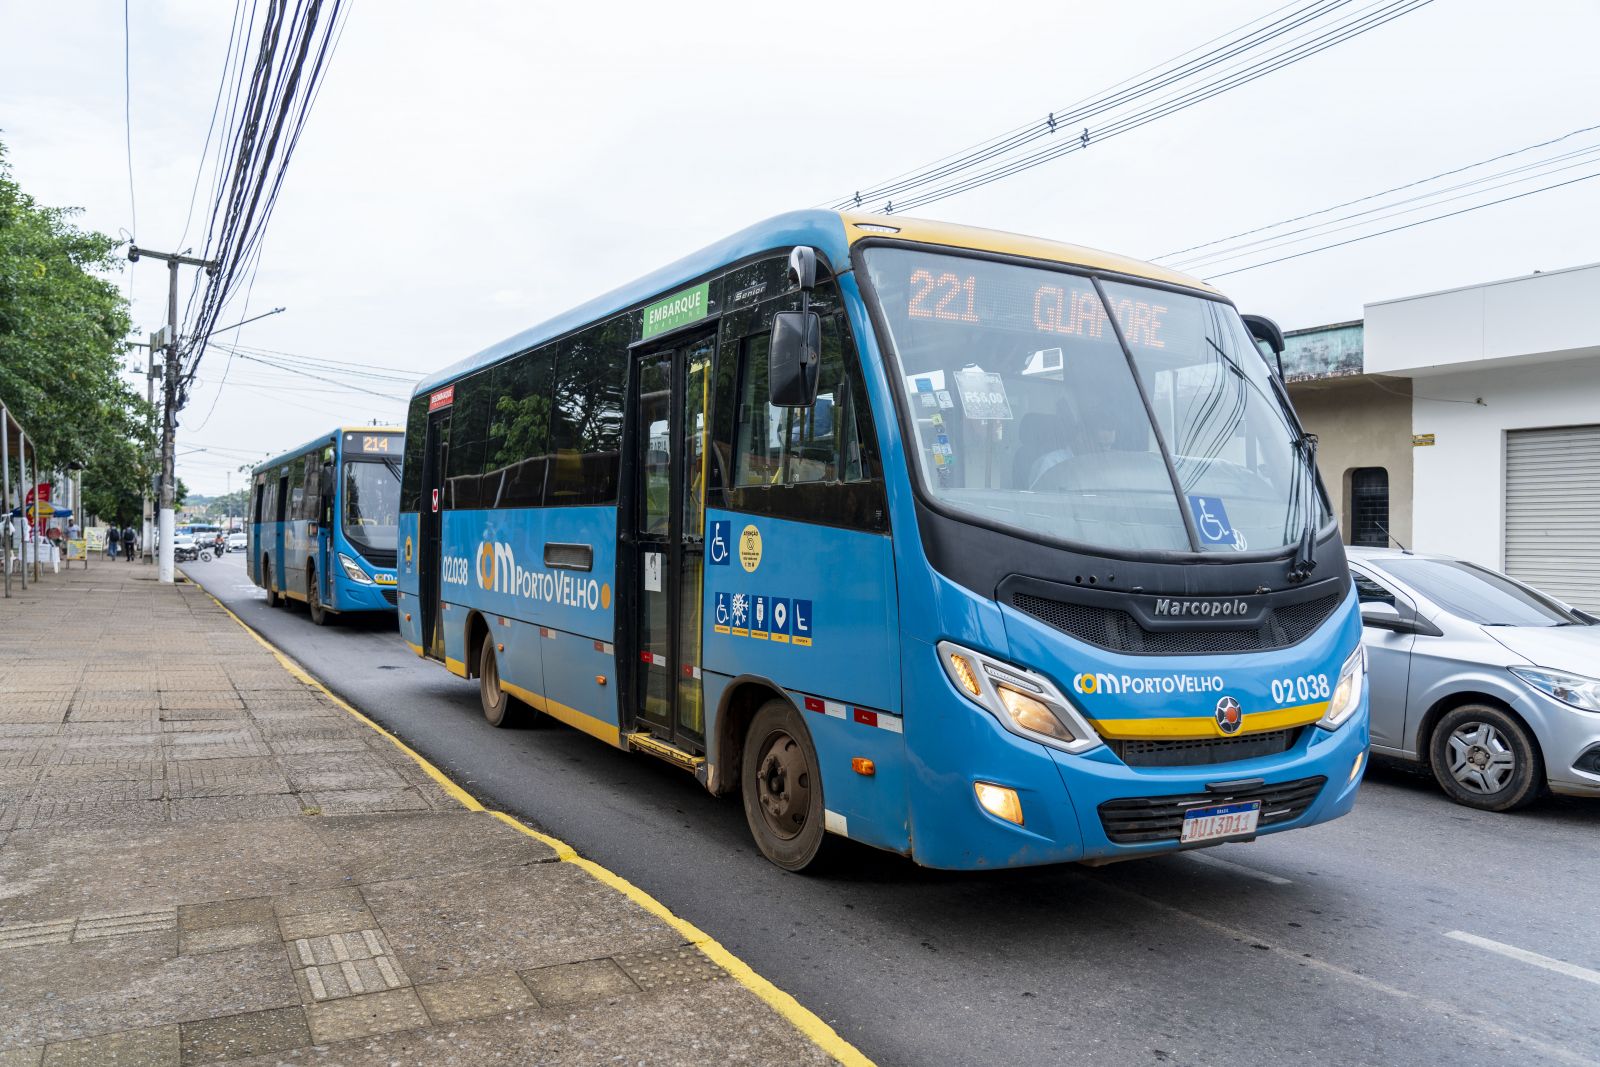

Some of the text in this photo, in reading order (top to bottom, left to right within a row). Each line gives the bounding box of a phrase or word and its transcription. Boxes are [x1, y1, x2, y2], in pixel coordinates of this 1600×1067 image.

[649, 291, 701, 324] EMBARQUE
[908, 269, 979, 322] 221
[362, 436, 387, 451] 214
[1154, 598, 1248, 617] Marcopolo
